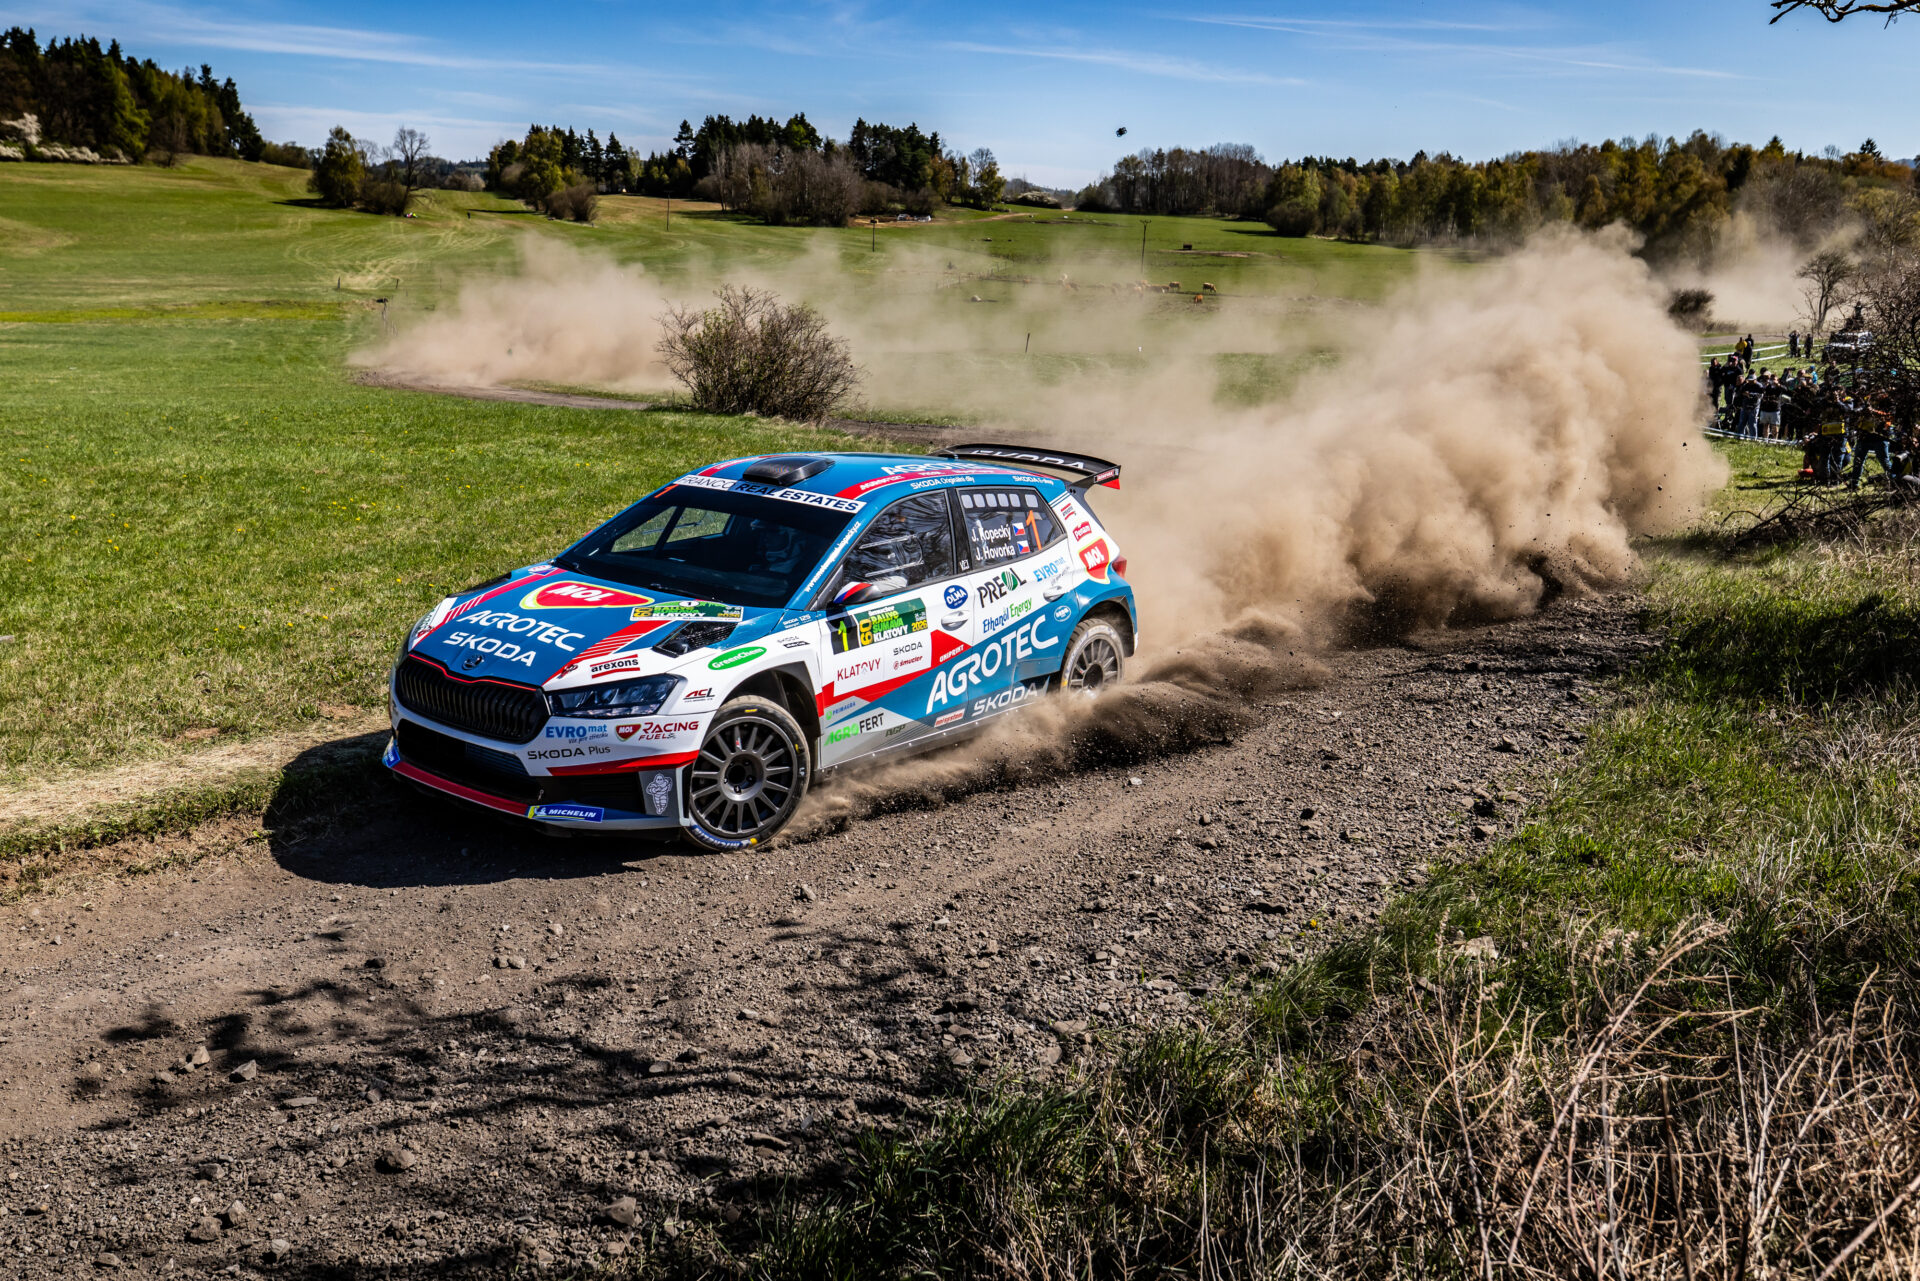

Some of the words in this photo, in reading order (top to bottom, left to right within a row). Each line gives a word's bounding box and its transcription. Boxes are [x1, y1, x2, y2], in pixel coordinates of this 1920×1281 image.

[678, 475, 736, 490] FRANCO
[735, 483, 775, 497] REAL
[778, 489, 860, 512] ESTATES
[971, 528, 980, 543] J.
[979, 523, 1012, 543] Kopecký
[1026, 509, 1042, 551] 1
[975, 546, 984, 561] J.
[983, 543, 1016, 560] Hovorka
[1084, 545, 1105, 570] MOL
[545, 584, 615, 602] MOL
[946, 589, 967, 605] OLMA
[1009, 597, 1033, 618] Energy
[456, 610, 586, 652] AGROTEC
[838, 620, 849, 652] 1
[872, 625, 909, 643] KLATOVY
[591, 658, 639, 673] arexons
[837, 657, 881, 682] KLATOVY
[925, 614, 1059, 716] AGROTEC
[685, 687, 716, 698] ACL
[618, 726, 634, 734] MOL
[641, 720, 700, 733] RACING
[588, 745, 611, 755] Plus
[548, 808, 597, 818] MICHELIN
